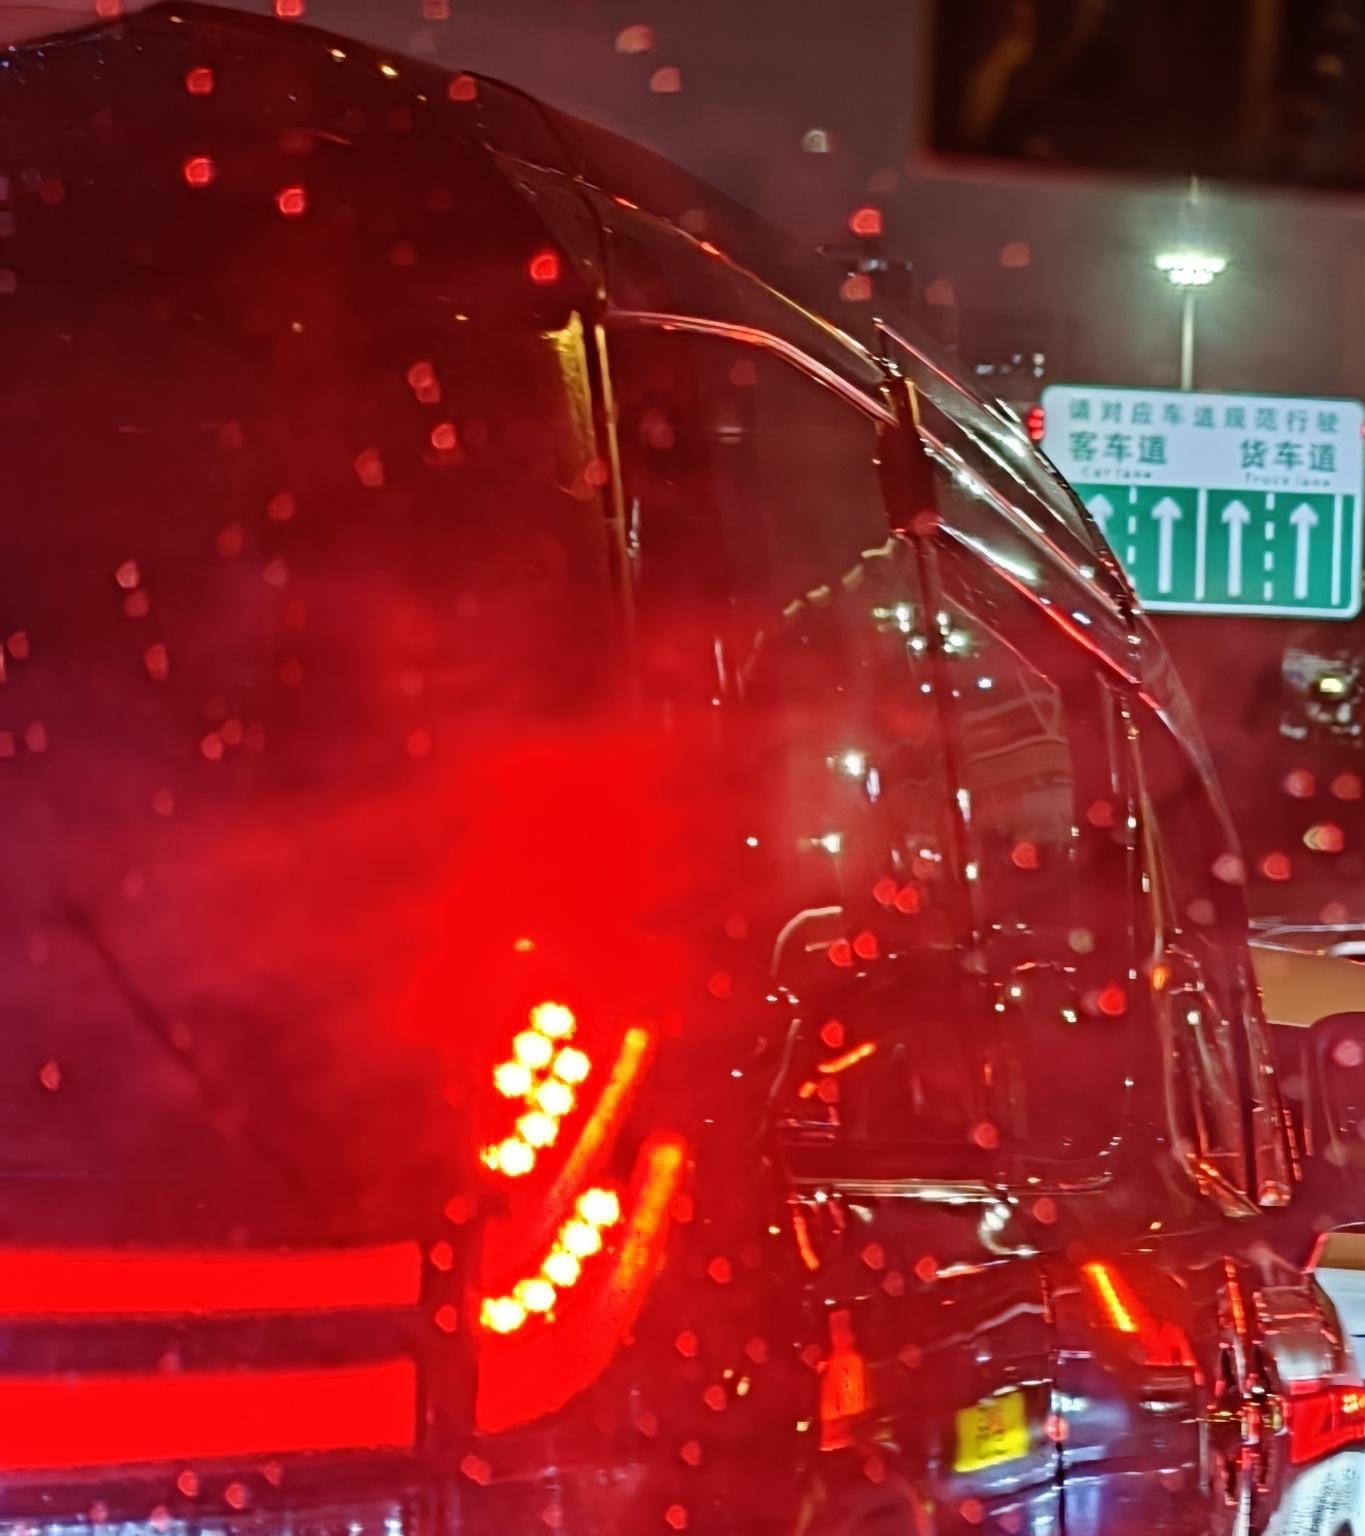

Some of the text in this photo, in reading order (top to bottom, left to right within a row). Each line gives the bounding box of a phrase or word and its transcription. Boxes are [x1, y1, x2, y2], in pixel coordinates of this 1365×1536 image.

[1069, 398, 1340, 434] 请对应车道规范行驶
[1069, 430, 1168, 465] 客车道
[1240, 437, 1337, 472] 货车道
